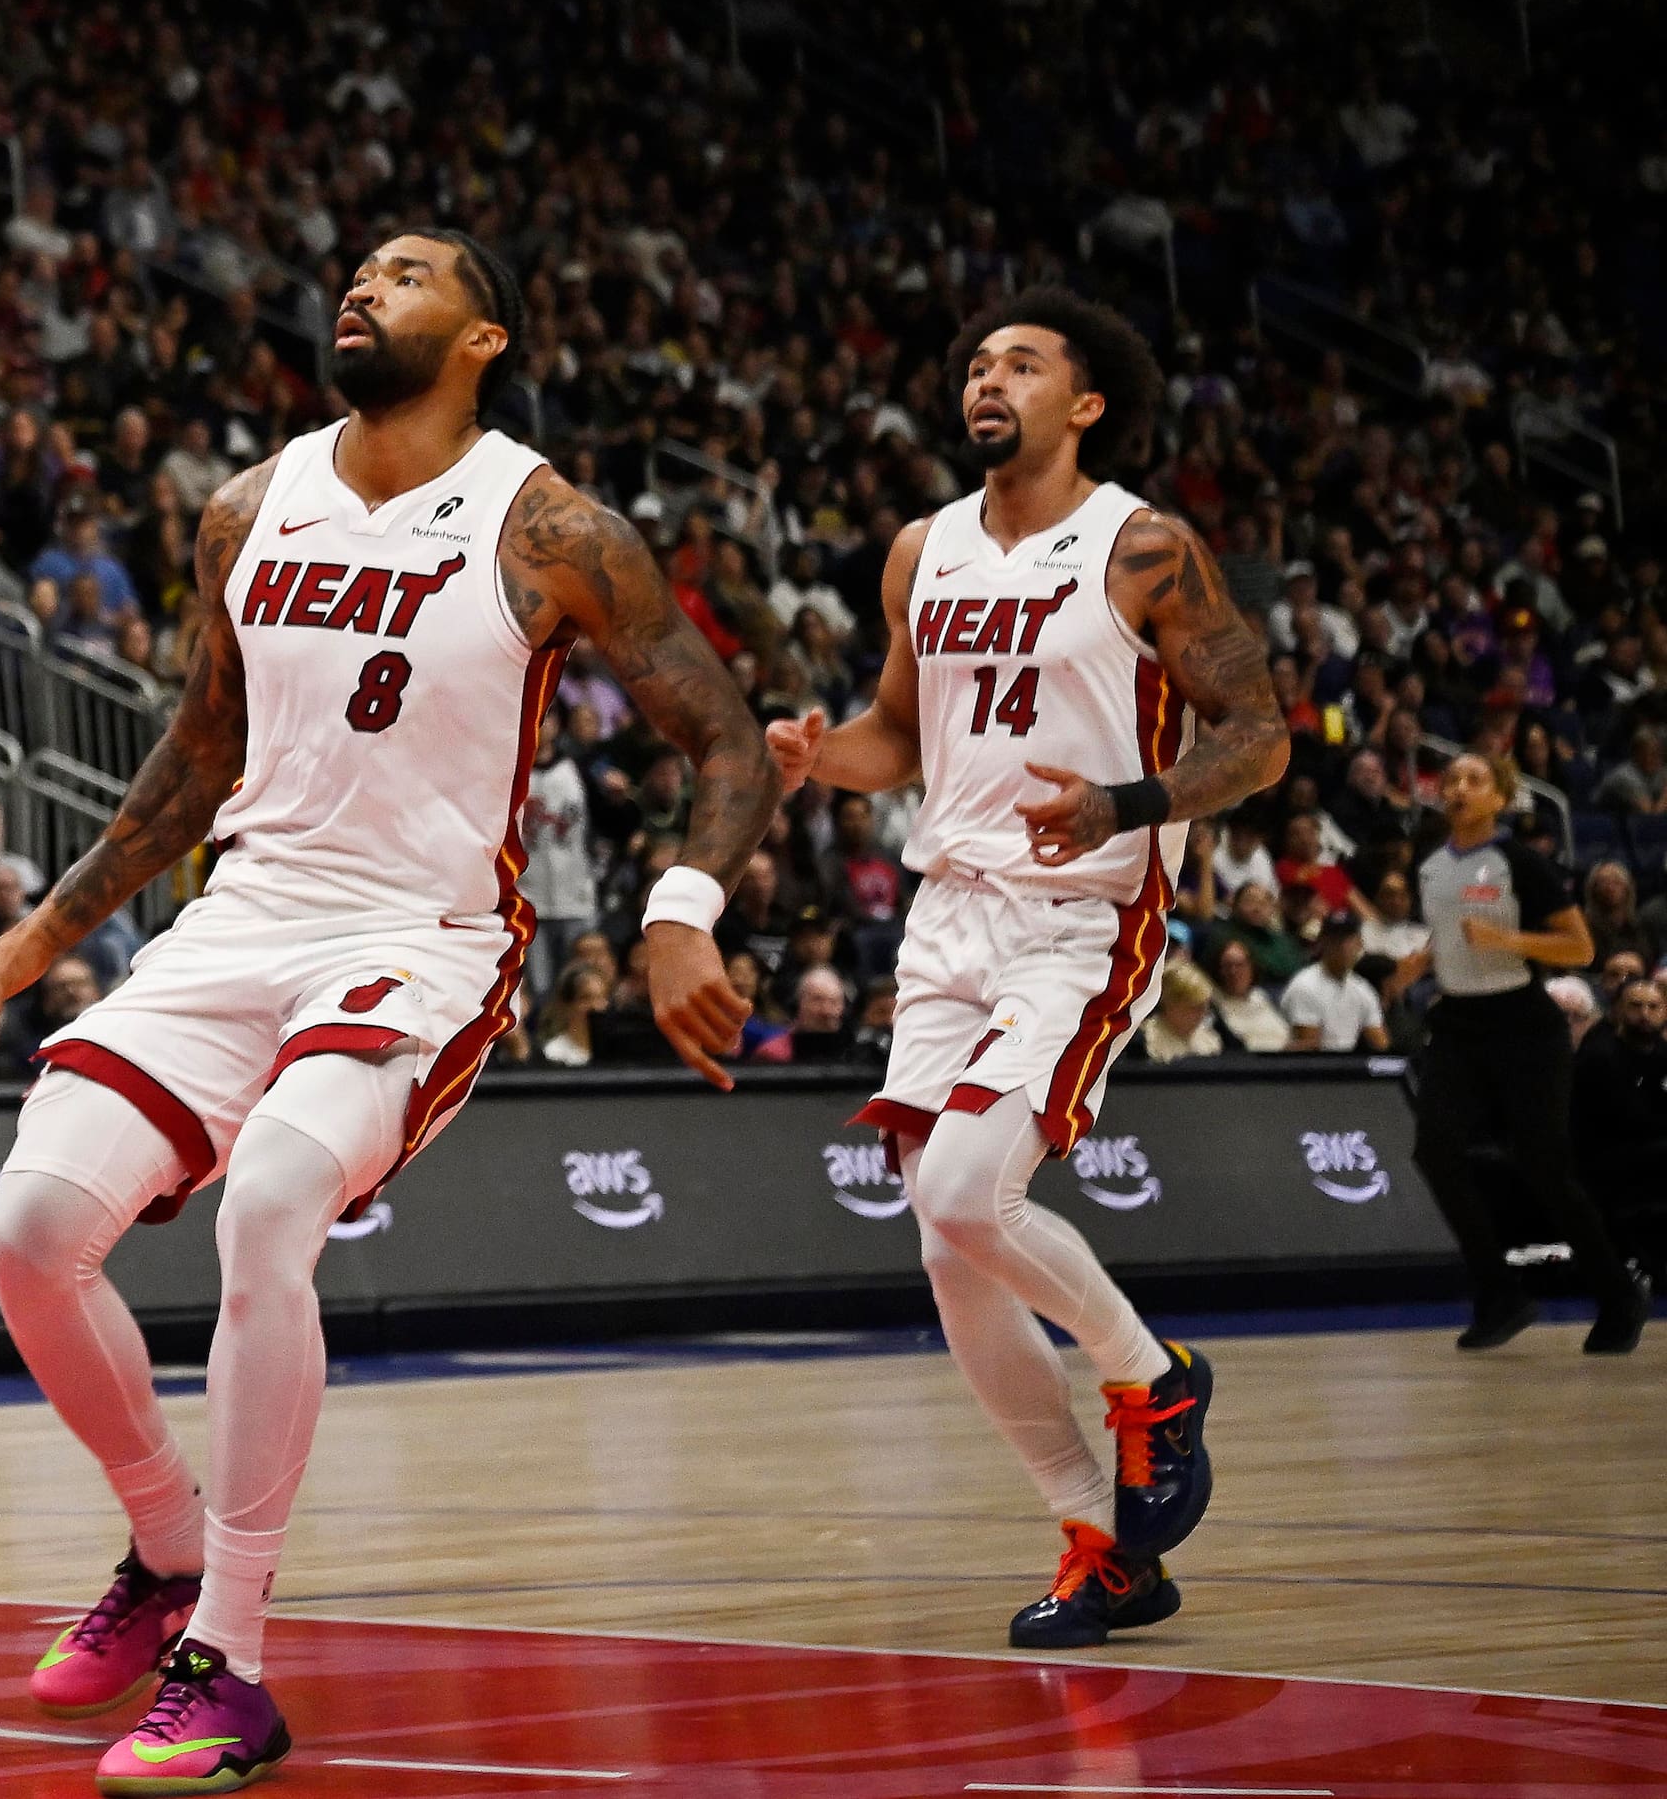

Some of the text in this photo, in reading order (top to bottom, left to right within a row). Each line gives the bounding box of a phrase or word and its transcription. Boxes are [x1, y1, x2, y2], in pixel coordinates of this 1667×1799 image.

[412, 526, 471, 544] Robinhood
[241, 552, 466, 638] HEAT
[917, 577, 1078, 657] HEAT
[345, 650, 413, 733] 8
[969, 666, 1041, 739] 14
[561, 1149, 652, 1196] aws
[1072, 1134, 1149, 1179] aws
[1300, 1130, 1377, 1173] aws
